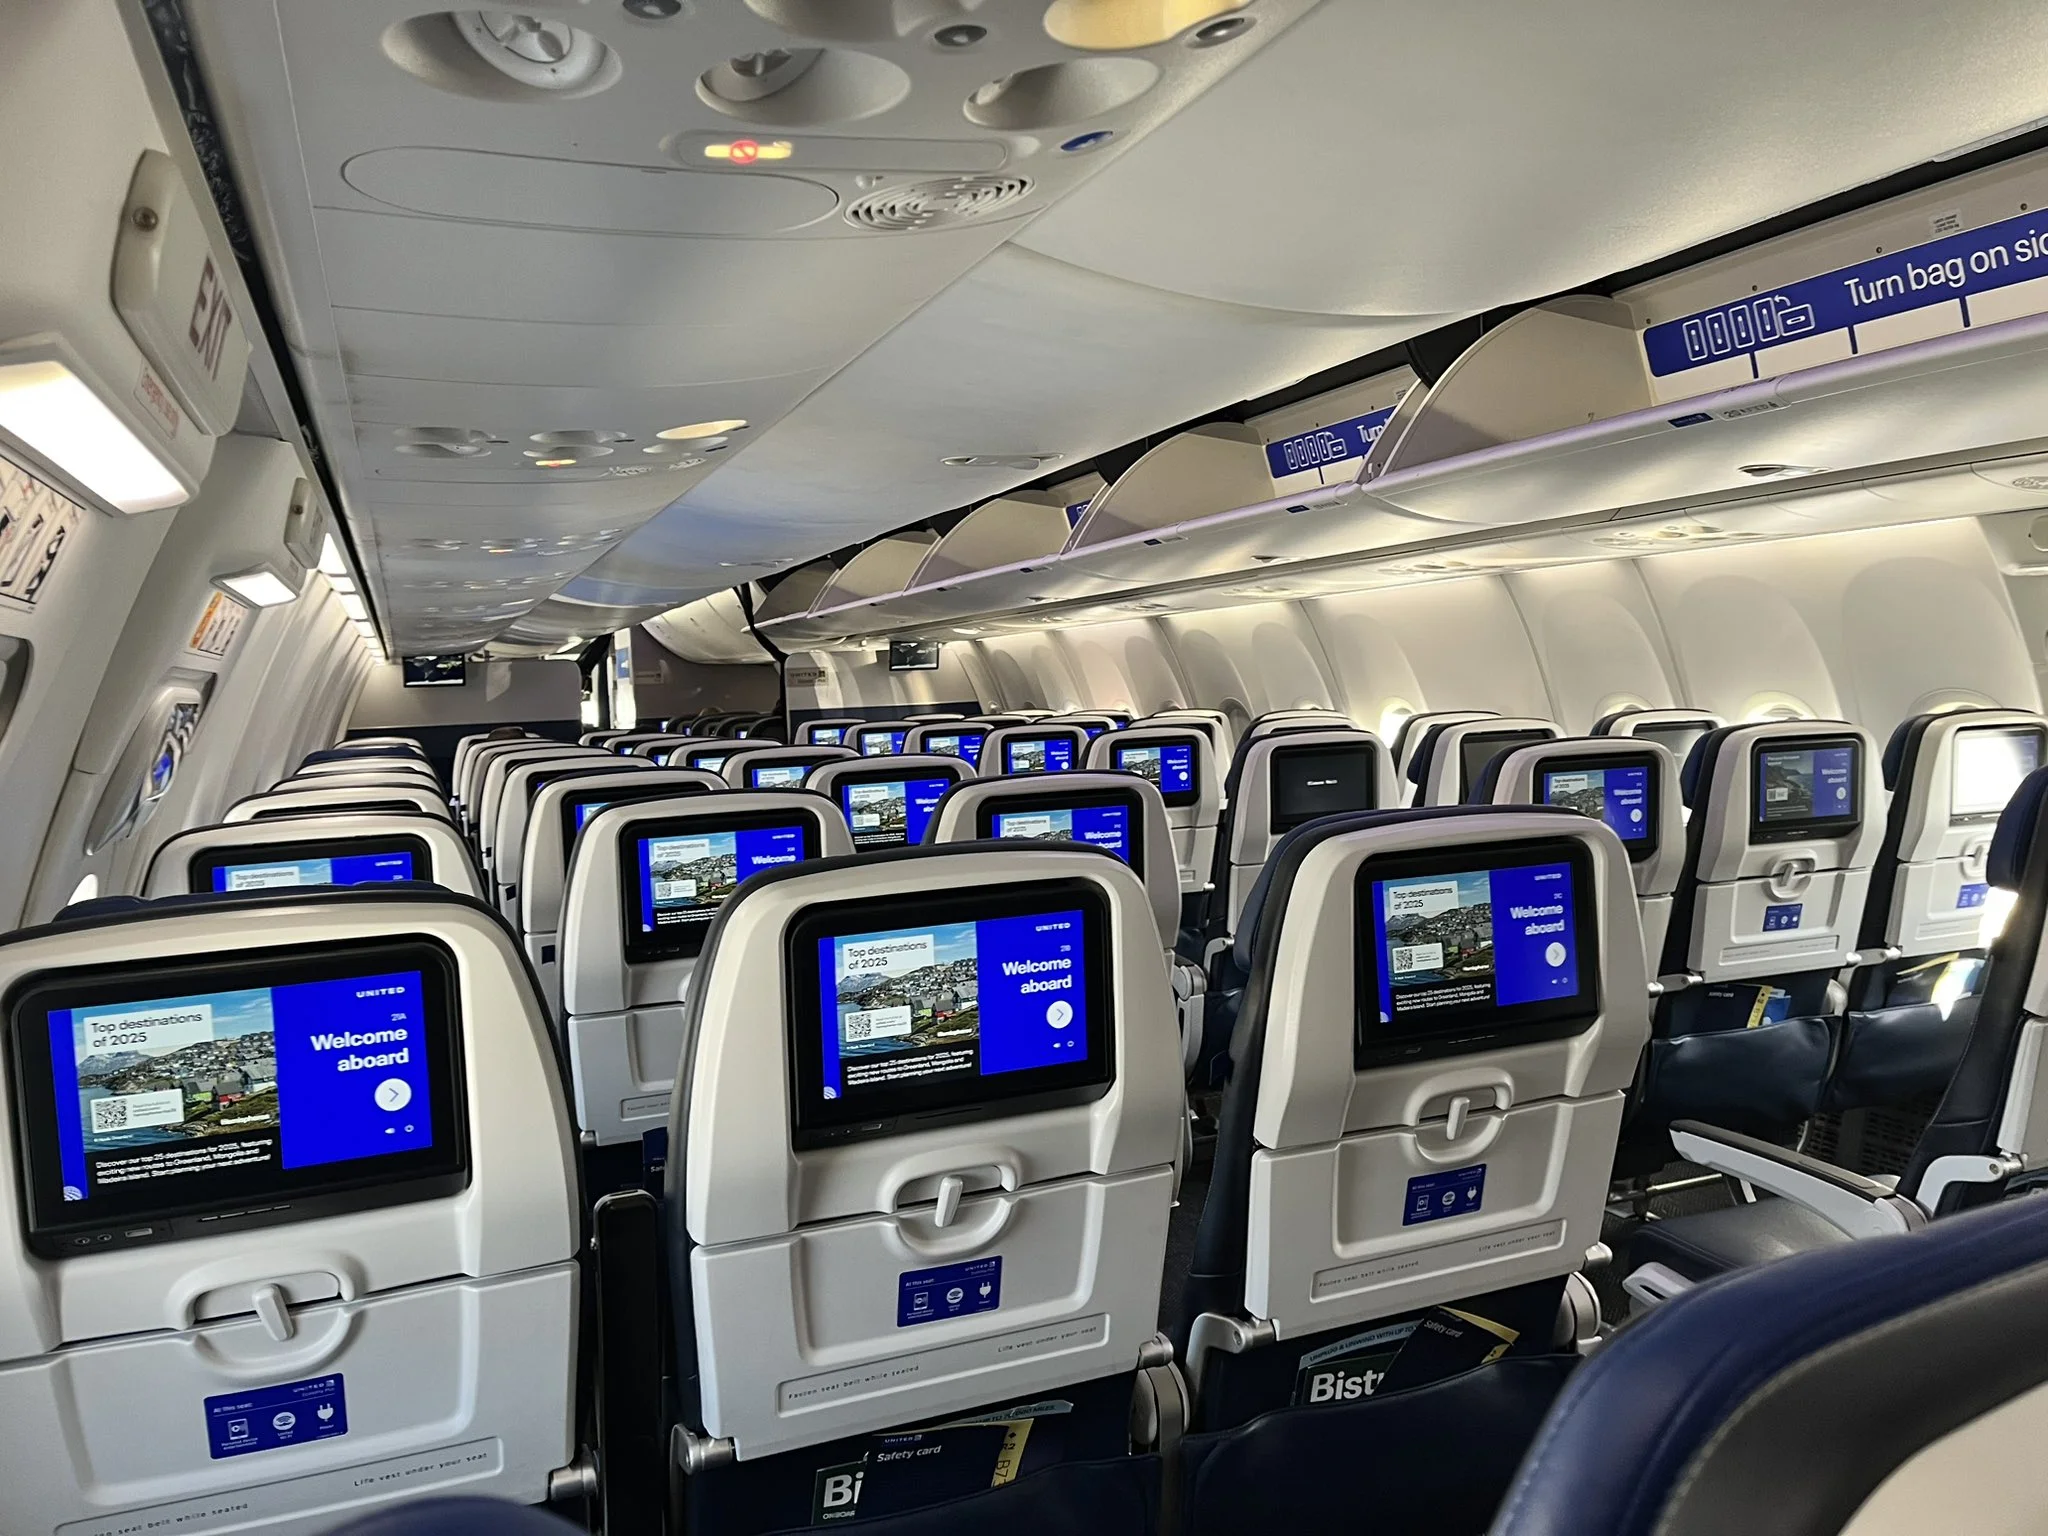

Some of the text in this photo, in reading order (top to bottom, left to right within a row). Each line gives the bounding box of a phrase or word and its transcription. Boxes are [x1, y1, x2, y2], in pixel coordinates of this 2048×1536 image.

[1844, 274, 1904, 307] Turn
[1906, 257, 1966, 289] bag
[1969, 246, 2009, 273] on
[751, 854, 796, 866] Welcome
[1393, 886, 1453, 901] Top destinations
[1394, 899, 1424, 911] of 2025
[1510, 904, 1564, 920] Welcome
[1034, 922, 1071, 932] UNITED
[1525, 920, 1565, 936] aboard
[848, 940, 928, 958] Top destinations
[848, 956, 888, 970] of 2025
[1002, 958, 1072, 976] Welcome
[355, 986, 406, 998] UNITED
[1020, 975, 1072, 996] aboard
[91, 1013, 203, 1034] Top destinations
[92, 1032, 147, 1048] of 2025
[310, 1028, 408, 1051] Welcome
[337, 1047, 410, 1072] aboard
[96, 1158, 127, 1168] Discover
[128, 1157, 140, 1165] our
[884, 1436, 913, 1444] UNITED
[876, 1445, 942, 1462] Safety card
[354, 1453, 487, 1487] Life vest under your seat
[212, 1503, 248, 1515] seated
